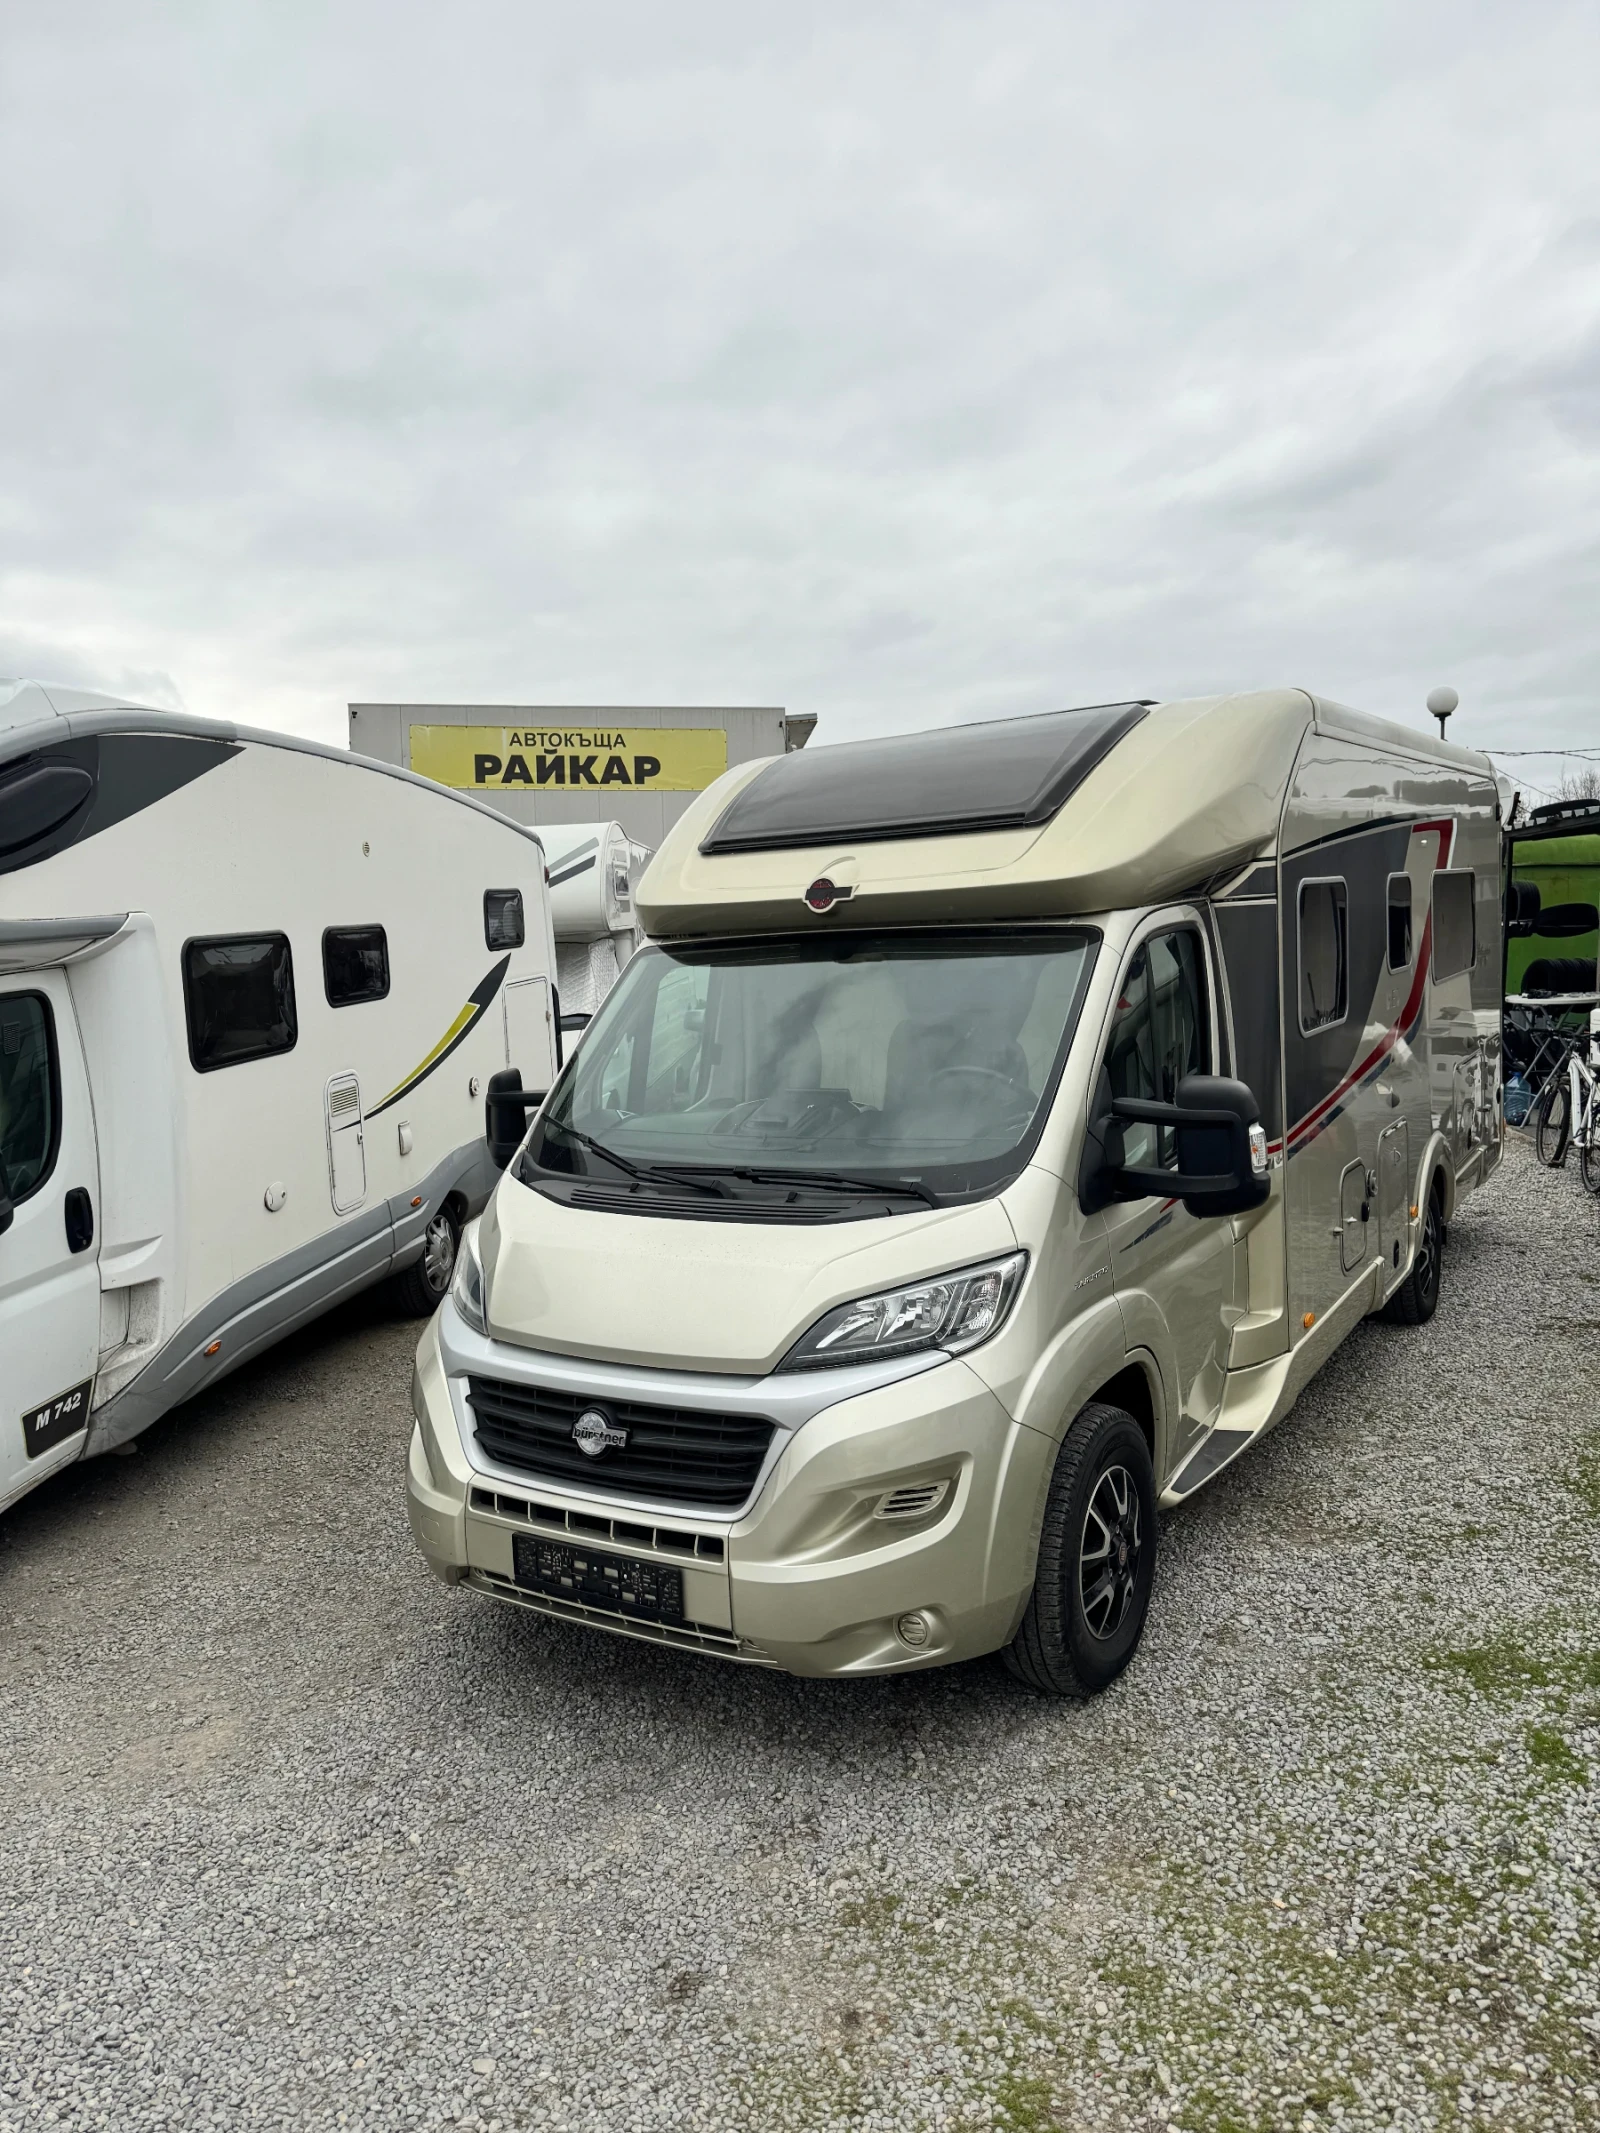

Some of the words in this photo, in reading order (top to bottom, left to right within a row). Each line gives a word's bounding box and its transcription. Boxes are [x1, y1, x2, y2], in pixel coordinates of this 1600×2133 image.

[509, 732, 627, 750] АВТОКЪЩА
[474, 748, 661, 785] РАЙКАР
[35, 1408, 51, 1431] M
[54, 1392, 82, 1420] 742
